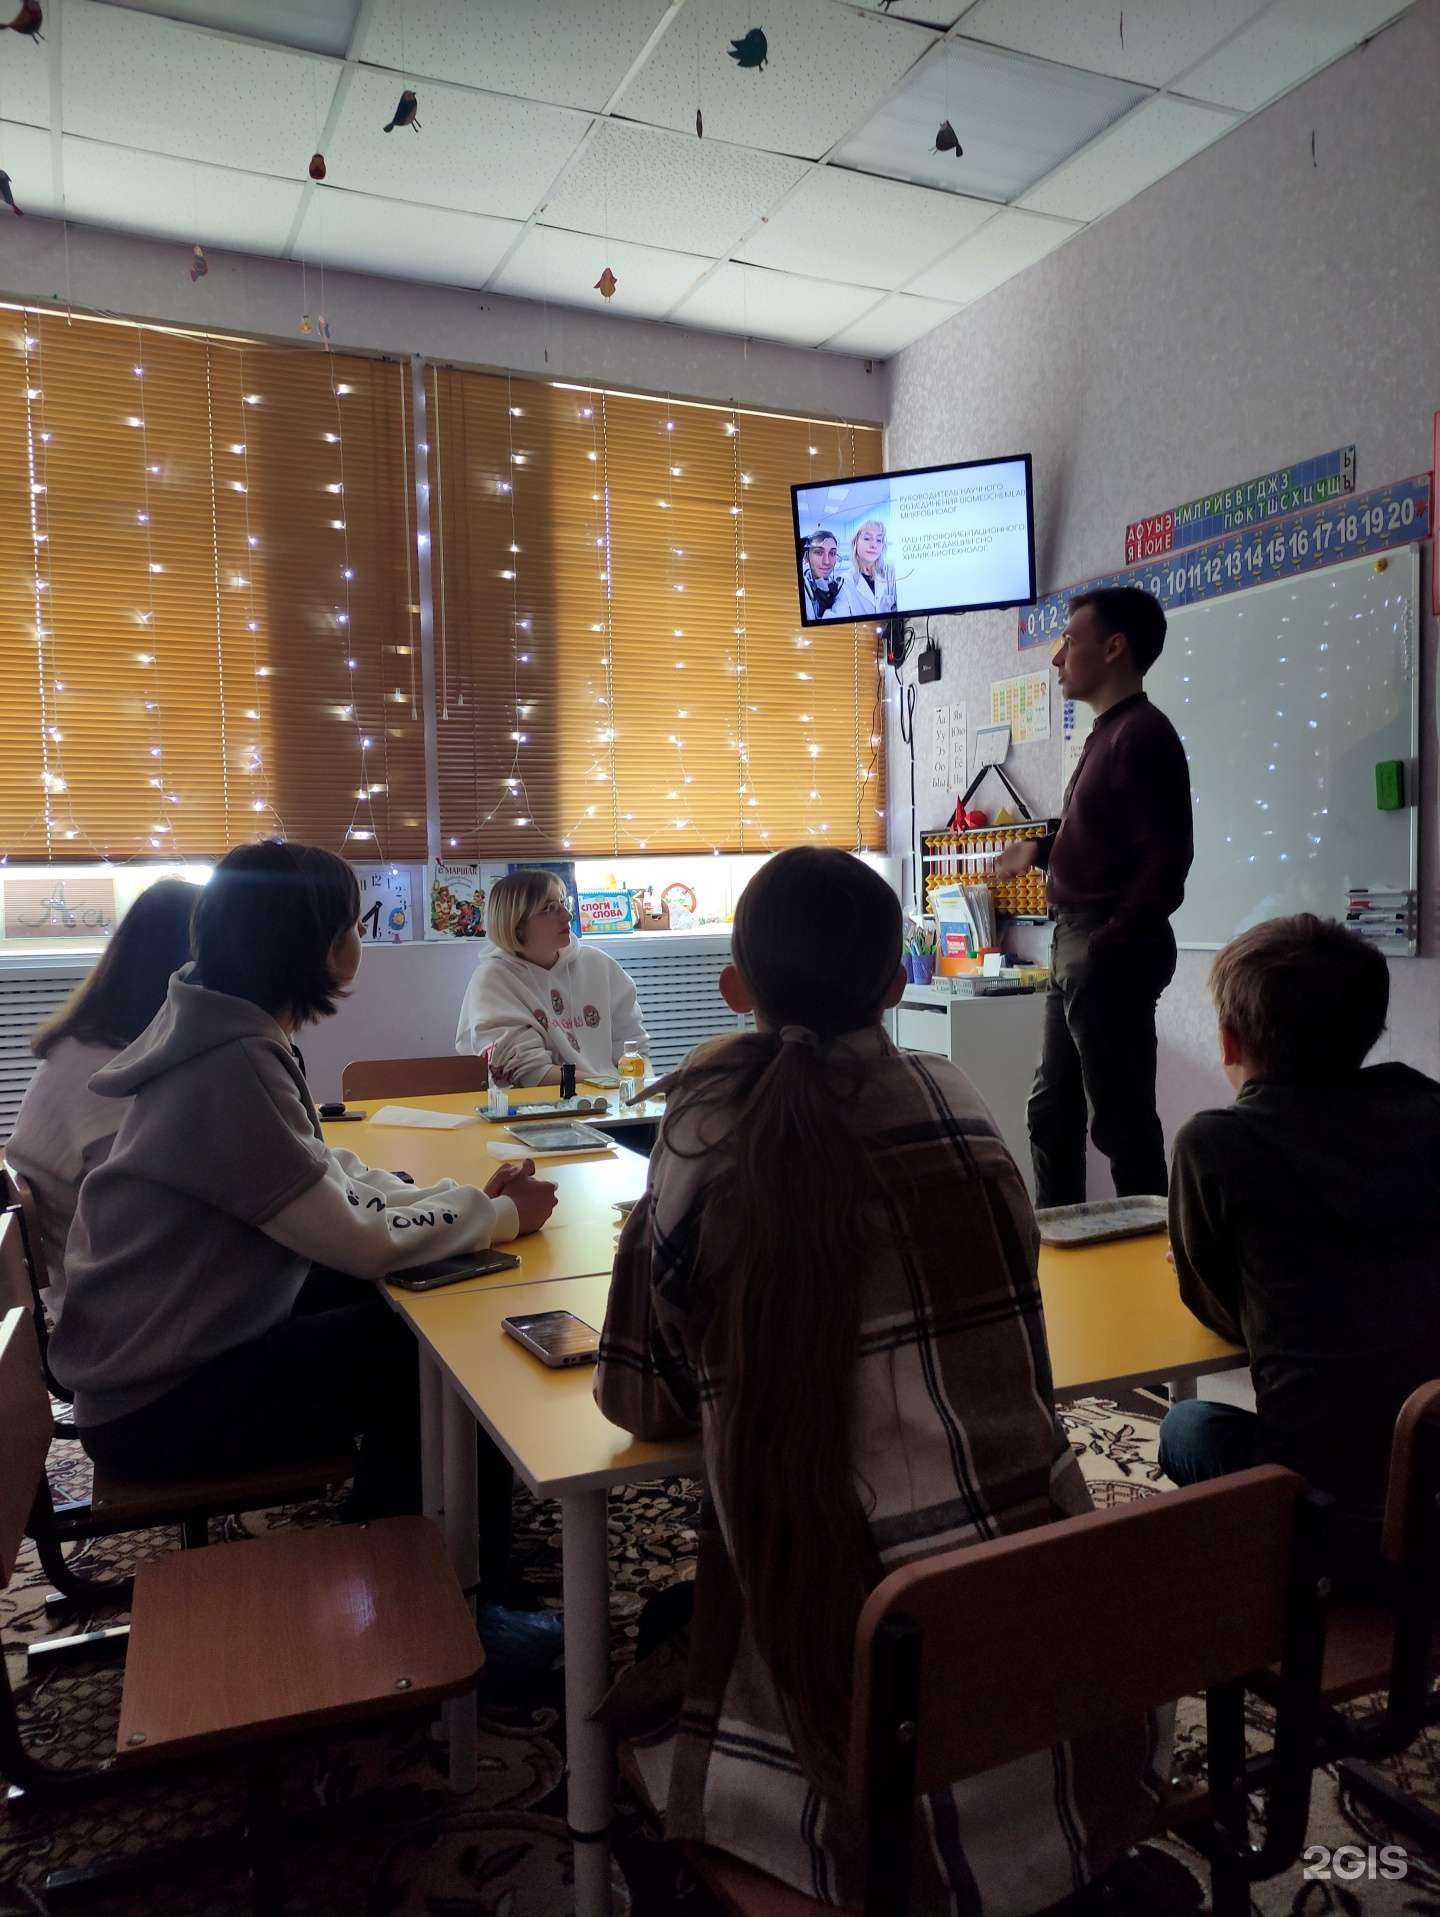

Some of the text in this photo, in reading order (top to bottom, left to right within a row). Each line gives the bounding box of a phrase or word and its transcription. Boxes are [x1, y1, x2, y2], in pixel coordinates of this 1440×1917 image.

[1167, 568, 1186, 595] 10
[1188, 564, 1201, 588] 11
[1204, 558, 1221, 583] 12
[1225, 551, 1241, 577] 13
[1245, 543, 1263, 571] 14
[1266, 536, 1285, 564] 15
[1289, 529, 1308, 558] 16
[1313, 522, 1333, 551] 17
[1337, 515, 1358, 544] 18
[1362, 507, 1384, 536] 19
[1387, 498, 1415, 530] 20
[372, 873, 382, 888] 12
[581, 901, 620, 912] СЛОГИ И
[592, 909, 624, 919] СЛОВА
